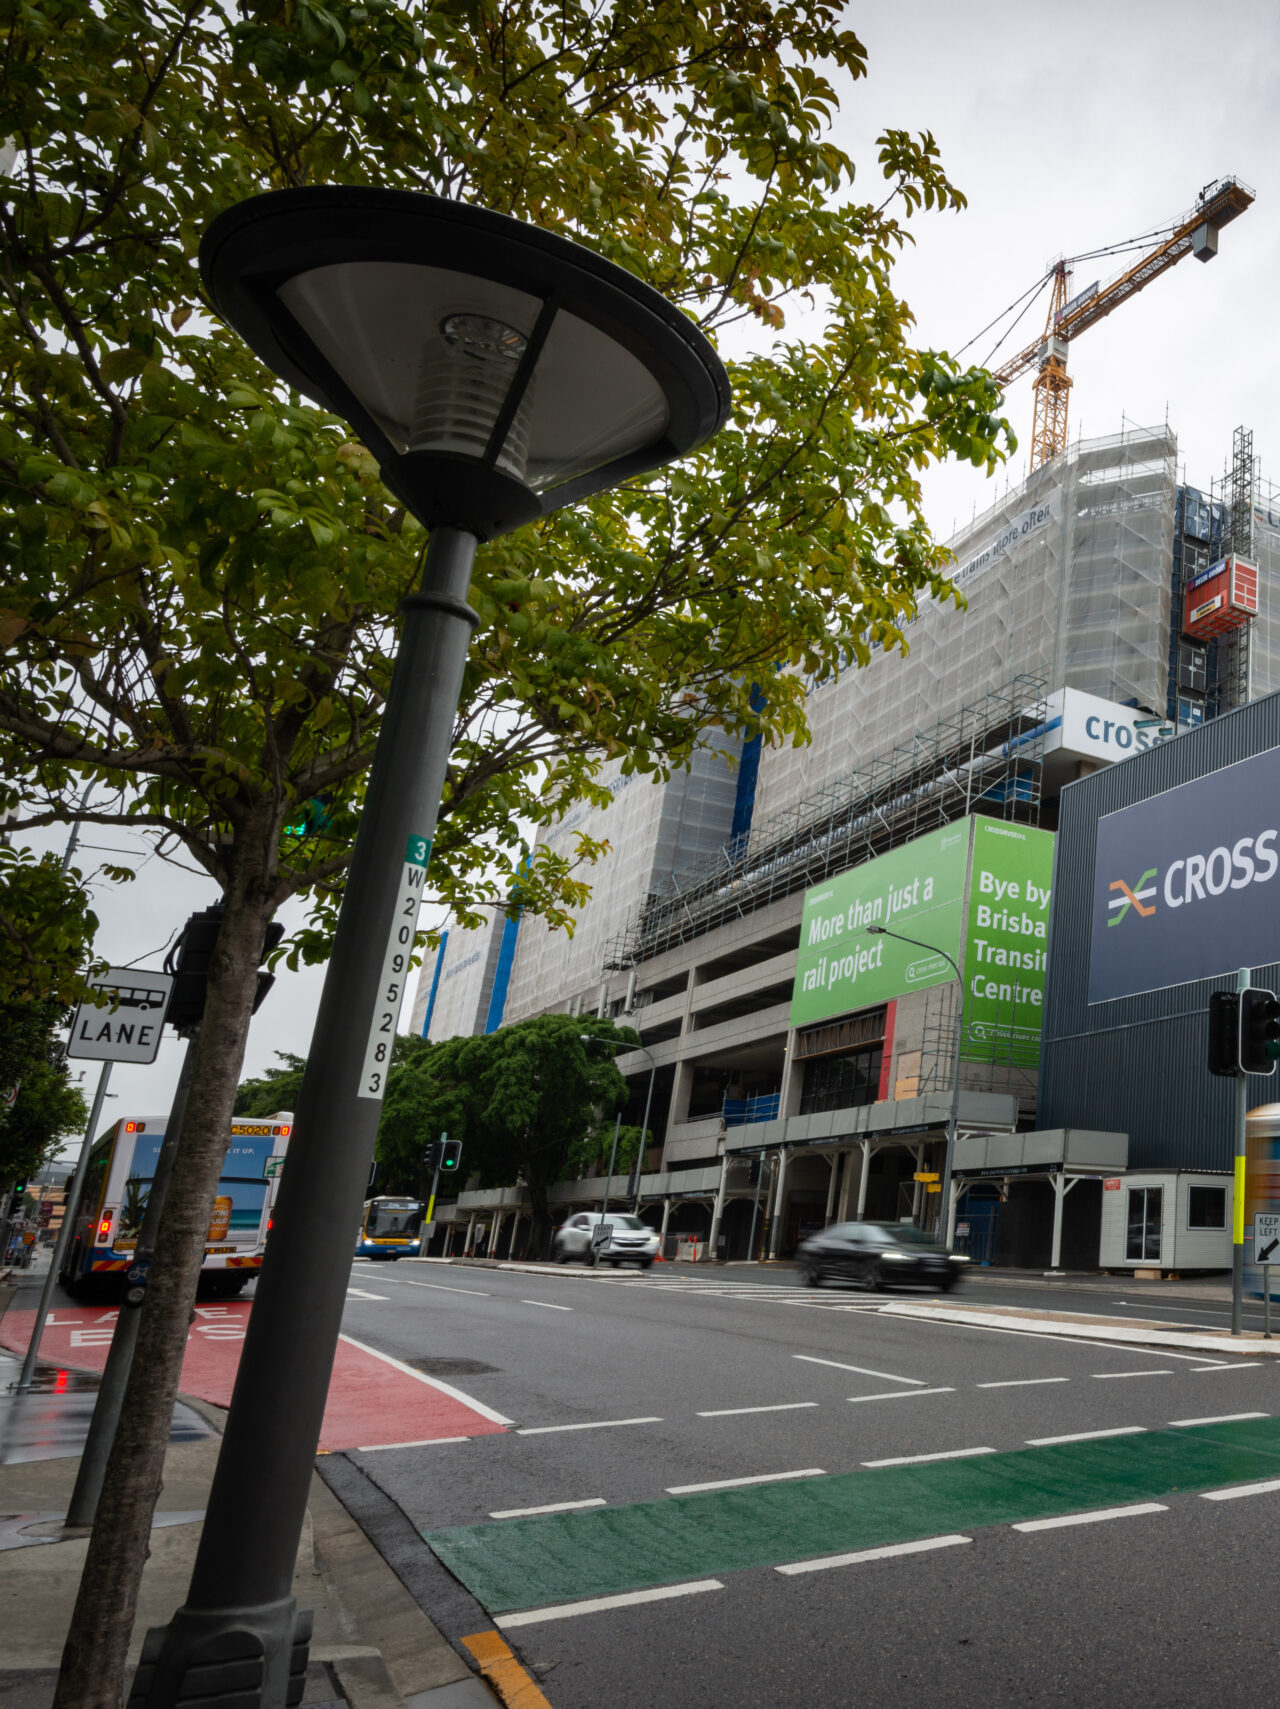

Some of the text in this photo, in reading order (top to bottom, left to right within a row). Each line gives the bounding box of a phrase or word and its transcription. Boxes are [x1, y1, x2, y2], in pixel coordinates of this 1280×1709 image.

[1021, 502, 1050, 534] often
[414, 841, 426, 861] 3
[979, 870, 1052, 910] Bye by
[808, 876, 934, 946] More than just a
[977, 904, 1045, 938] Brisba
[802, 939, 884, 992] rail project
[971, 974, 1043, 1006] Centre
[79, 1019, 154, 1046] LANE
[1259, 1216, 1279, 1226] KEEP
[1260, 1227, 1278, 1237] LEFT
[70, 1324, 246, 1347] BS
